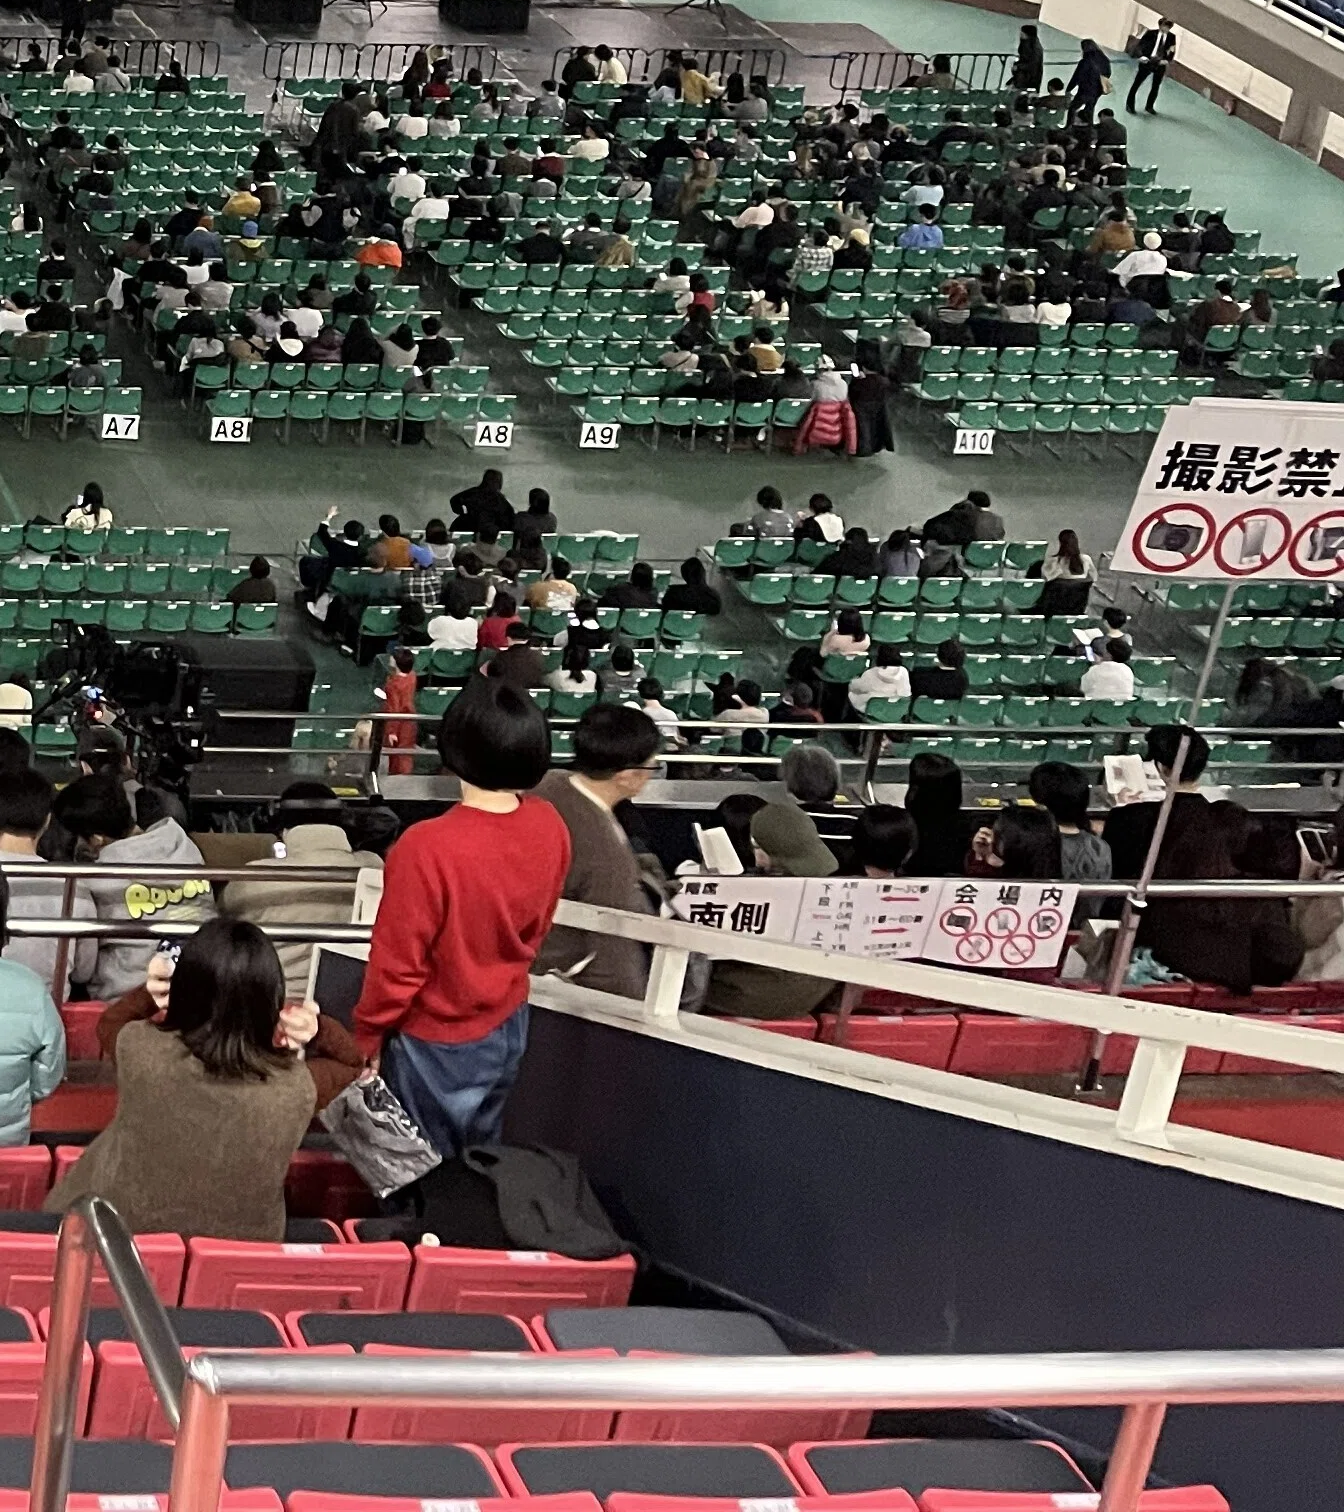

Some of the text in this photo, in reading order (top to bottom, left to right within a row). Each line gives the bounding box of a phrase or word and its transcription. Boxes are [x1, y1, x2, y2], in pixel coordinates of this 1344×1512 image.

[105, 417, 136, 436] A7
[215, 420, 244, 438] A8
[478, 425, 508, 444] A8
[584, 425, 614, 445] A9
[958, 432, 989, 451] A10
[954, 883, 1063, 906] 会場内
[690, 901, 770, 935] 南側
